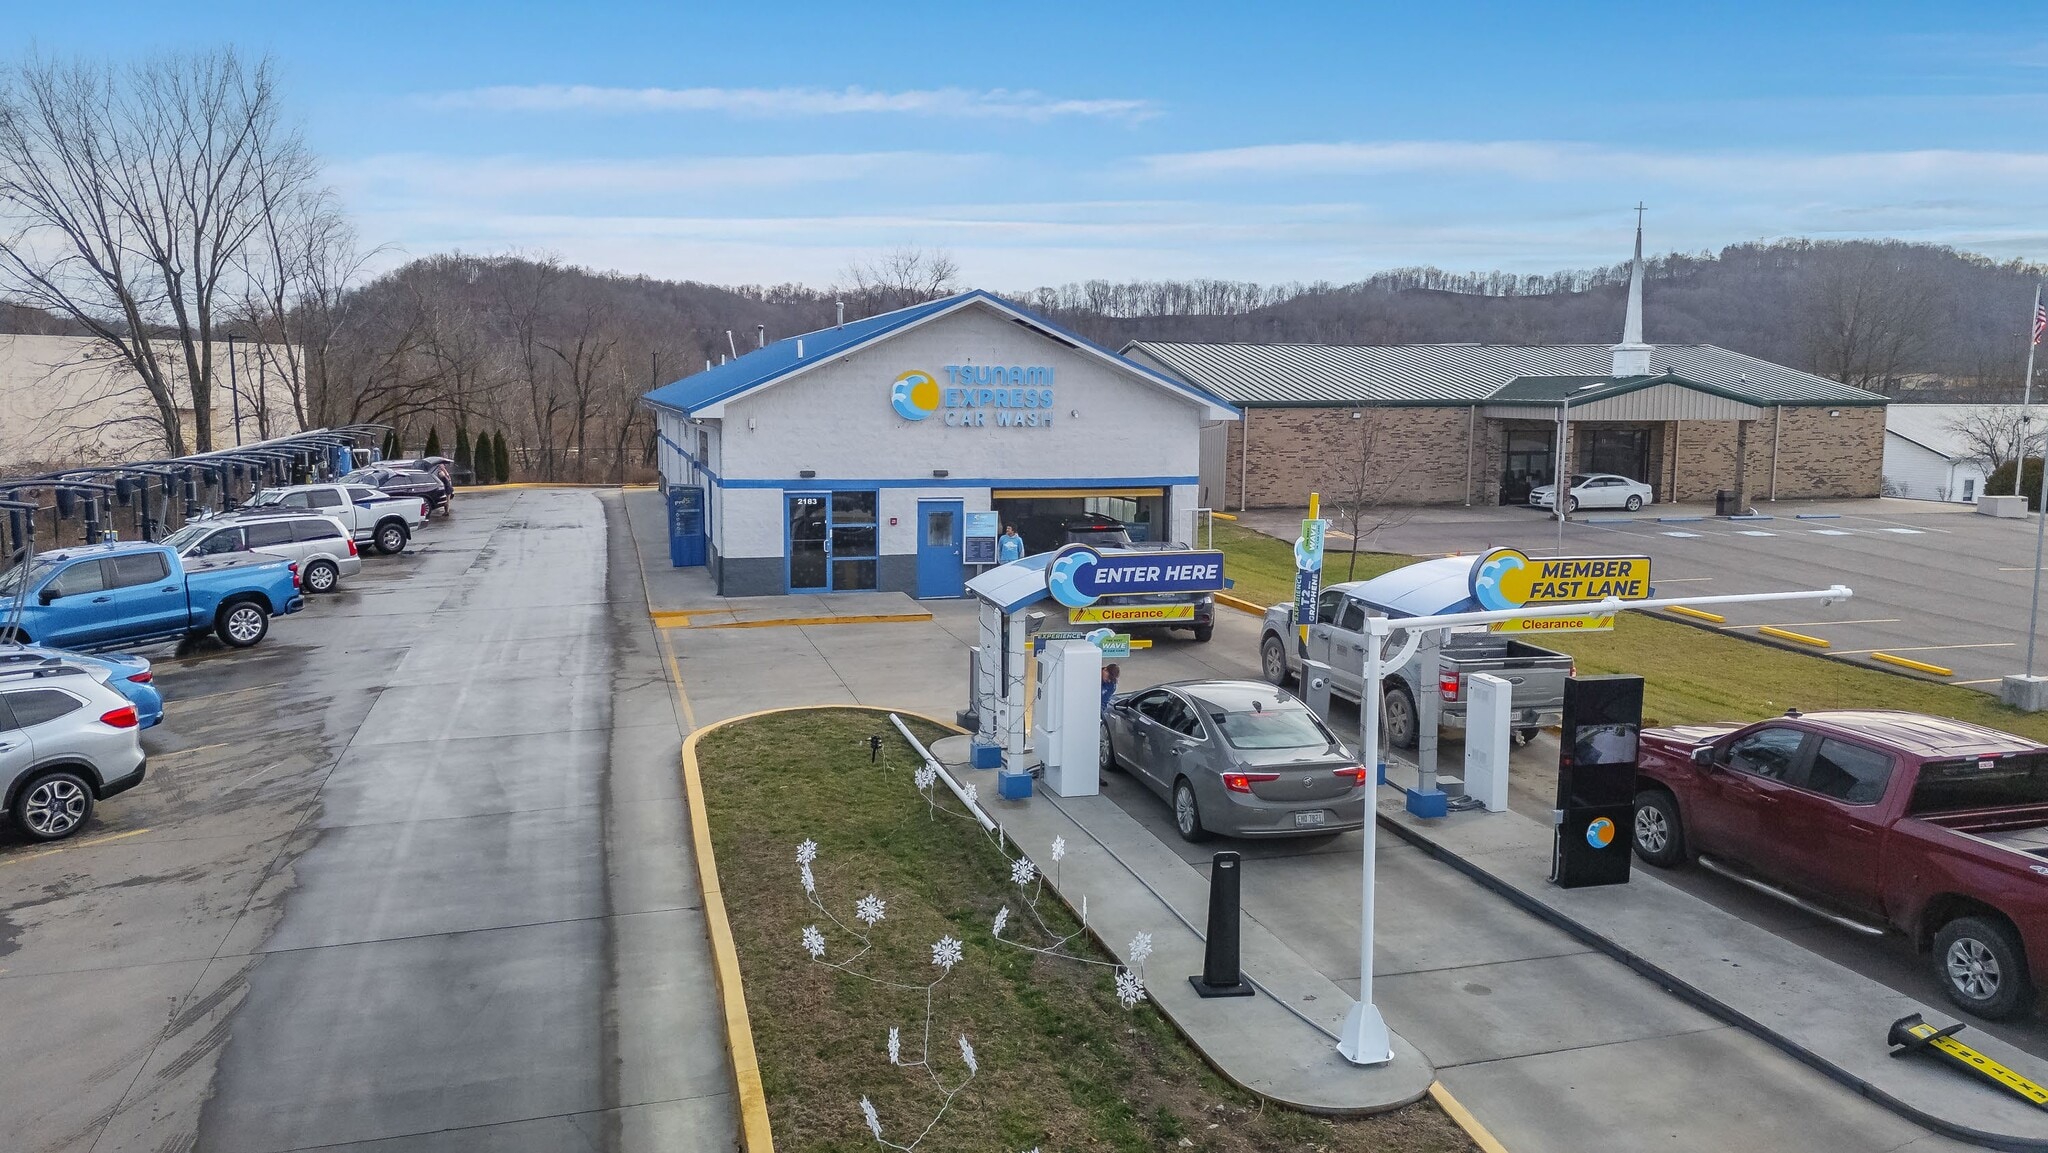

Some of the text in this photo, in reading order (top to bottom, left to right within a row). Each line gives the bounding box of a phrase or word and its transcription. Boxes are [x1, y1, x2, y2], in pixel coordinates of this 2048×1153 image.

[944, 365, 1055, 386] TSUNAMI
[944, 388, 1055, 408] EXPRESS
[944, 410, 1054, 427] CAR WASH
[1309, 524, 1317, 550] WAVE
[1094, 564, 1218, 584] ENTER HERE
[1541, 561, 1632, 579] MEMBER
[1301, 590, 1310, 606] T2
[1309, 573, 1318, 622] GRAPHENE
[1530, 580, 1641, 598] FAST LANE
[1102, 610, 1163, 620] Clearance
[1522, 619, 1583, 630] Clearance
